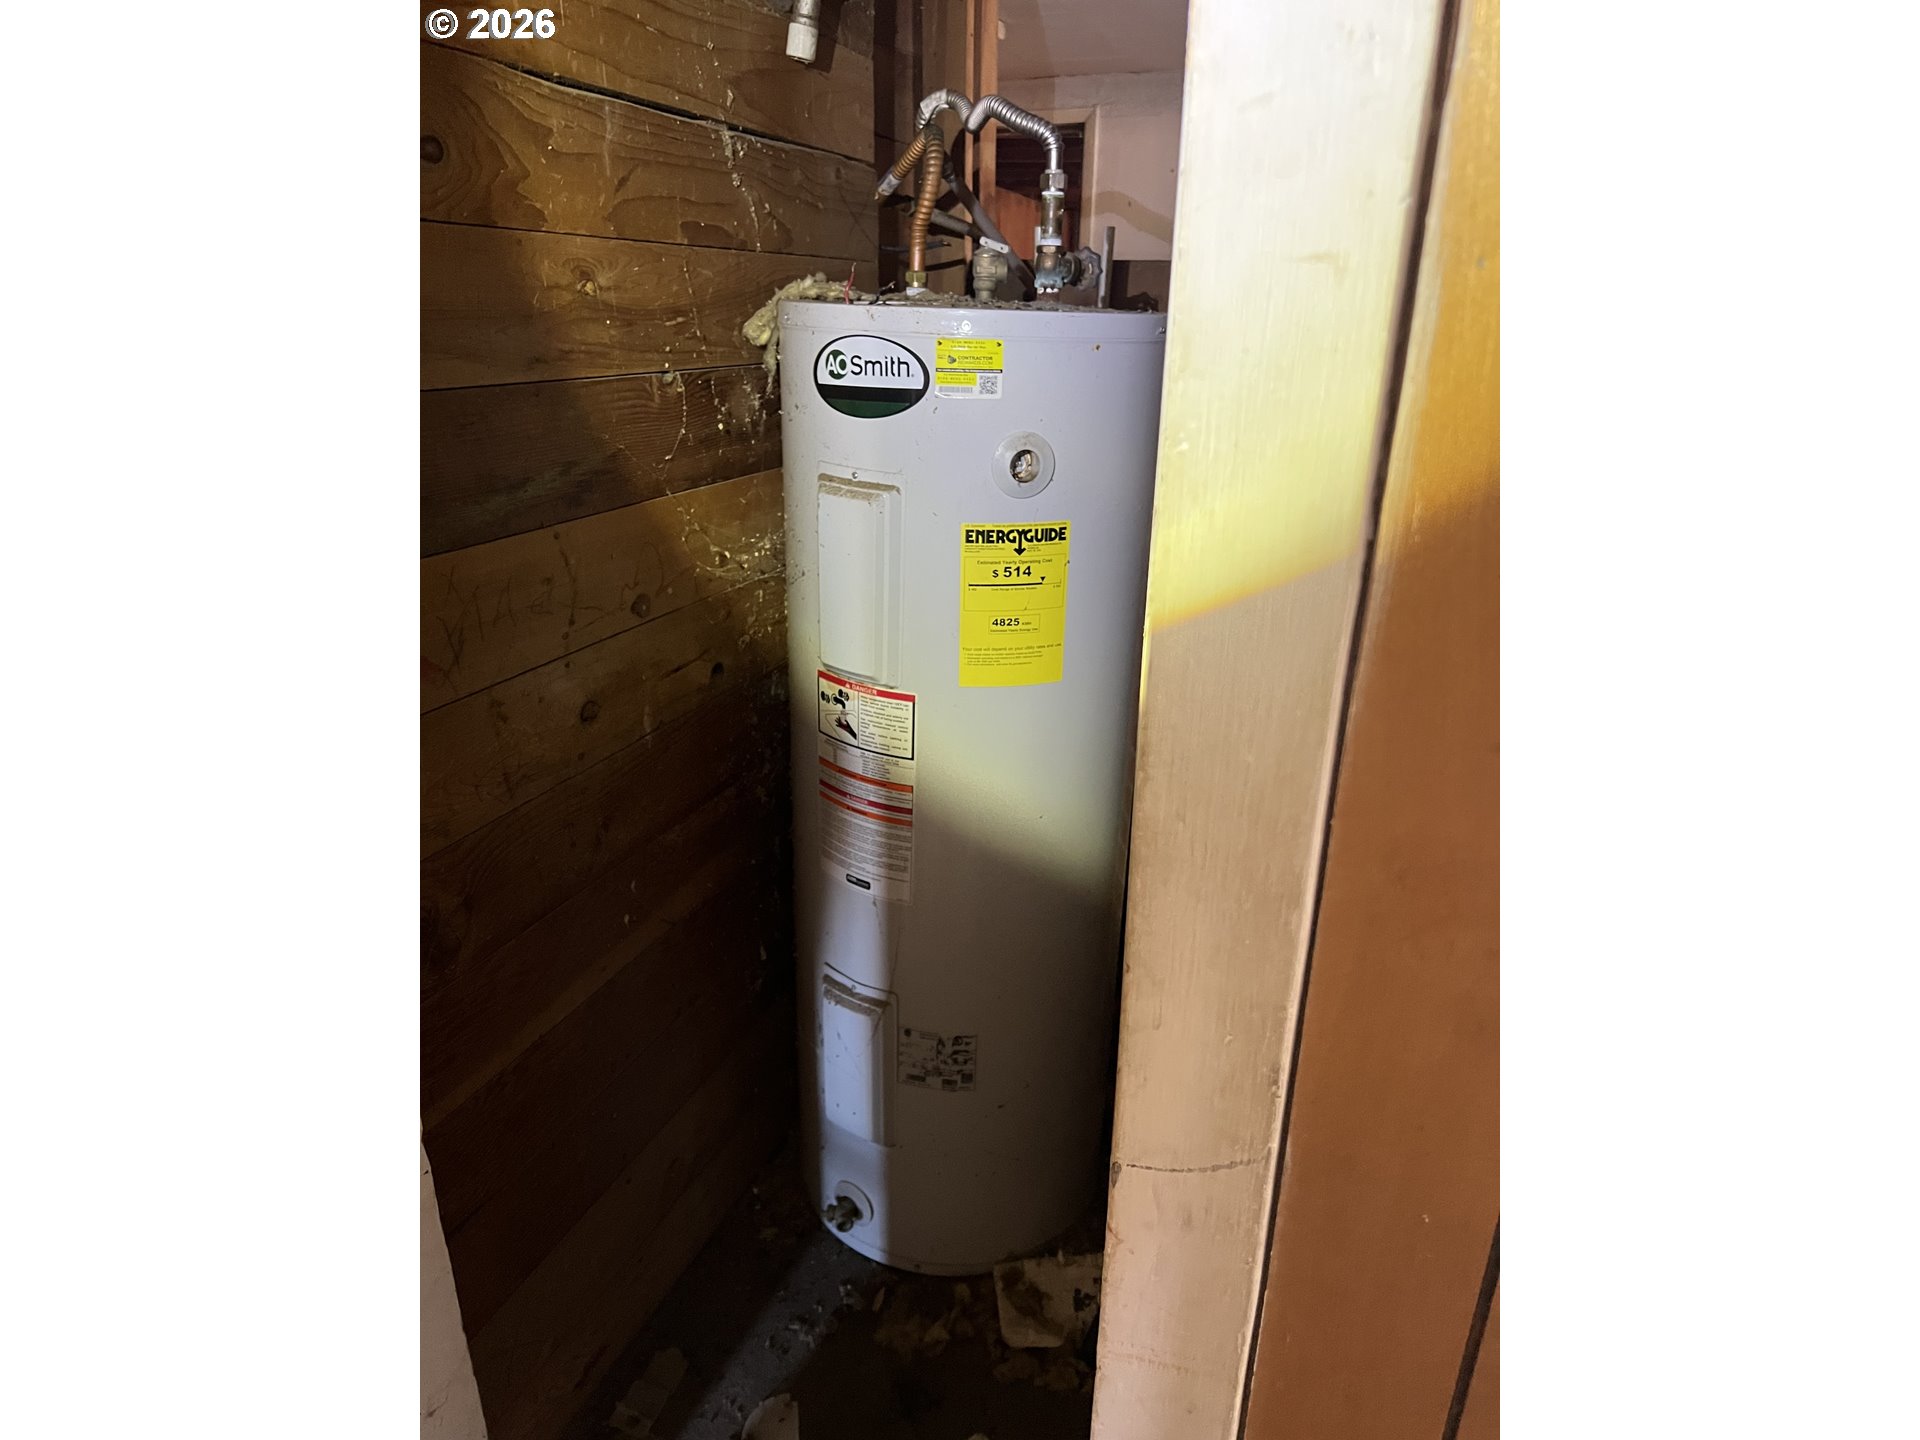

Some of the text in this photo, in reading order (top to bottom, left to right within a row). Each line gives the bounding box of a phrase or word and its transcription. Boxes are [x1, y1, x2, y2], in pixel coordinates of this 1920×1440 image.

[850, 355, 911, 379] Smith
[965, 527, 1067, 544] ENERGYGUIDE
[1003, 565, 1032, 578] 514
[992, 618, 1020, 627] 4825
